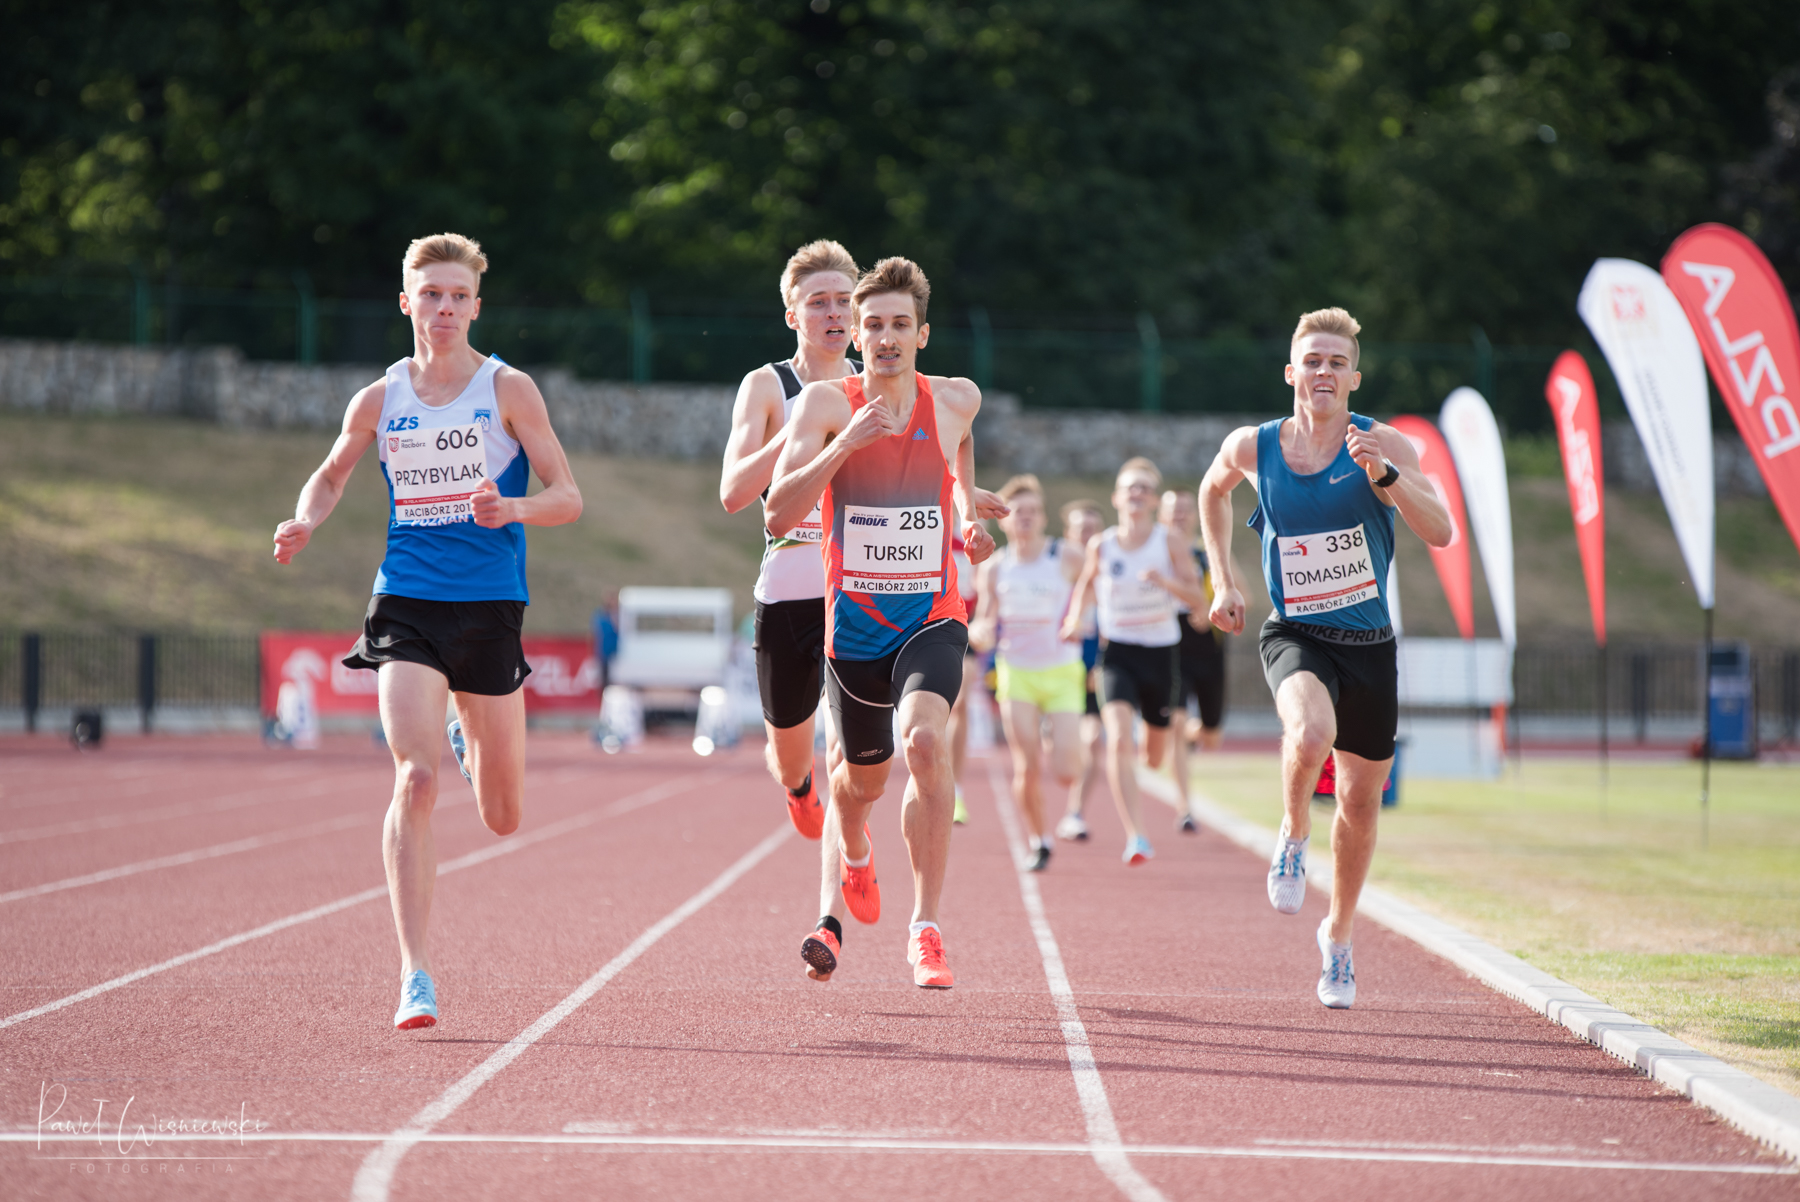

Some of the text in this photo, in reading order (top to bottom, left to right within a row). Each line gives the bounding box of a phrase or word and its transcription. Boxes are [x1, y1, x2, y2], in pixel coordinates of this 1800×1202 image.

[386, 416, 419, 432] AZS
[436, 428, 478, 451] 606
[395, 462, 485, 486] PRZYBYLAK
[404, 504, 451, 517] RACIBÓRZ
[899, 510, 939, 530] 285
[1326, 530, 1364, 553] 338
[864, 545, 923, 561] TURSKI
[1286, 558, 1368, 586] TOMASIAK
[853, 580, 929, 592] RACIBÓRZ 2019
[1296, 591, 1367, 613] RACIBÓRZ 2019
[1300, 623, 1340, 641] NIKE
[1341, 629, 1376, 643] PRO
